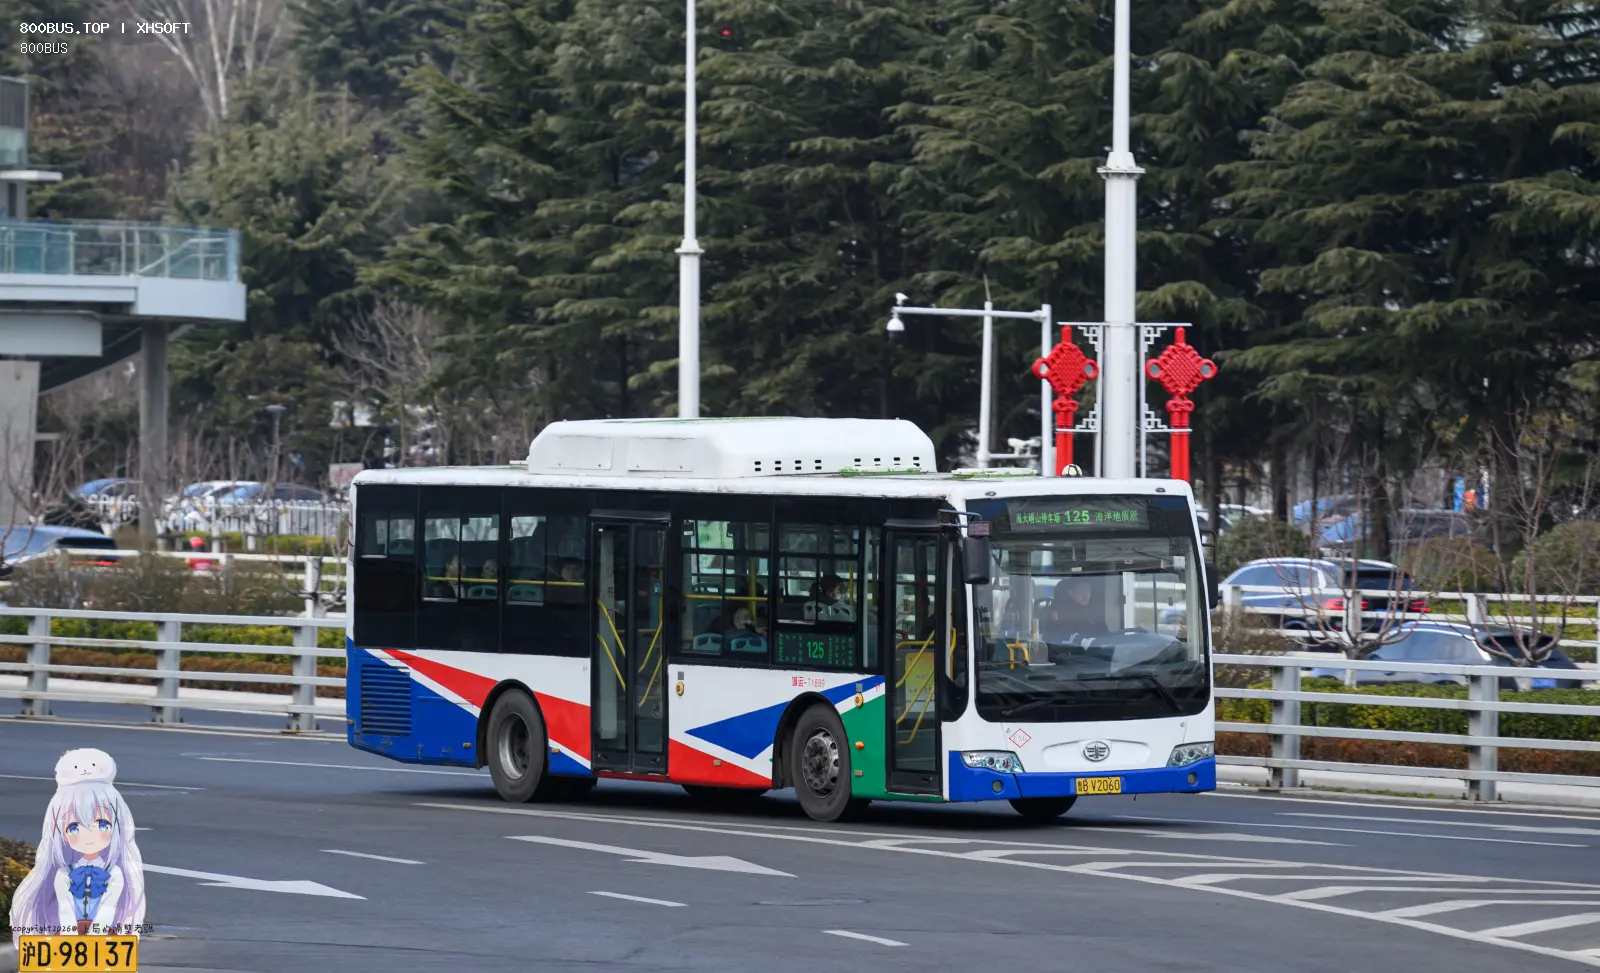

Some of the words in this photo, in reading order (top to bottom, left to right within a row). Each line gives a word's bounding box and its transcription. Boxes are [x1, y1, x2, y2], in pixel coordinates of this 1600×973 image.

[1064, 509, 1090, 522] 125
[1094, 510, 1138, 523] 海洋地质所
[807, 641, 824, 659] 125
[1013, 734, 1027, 742] CNG
